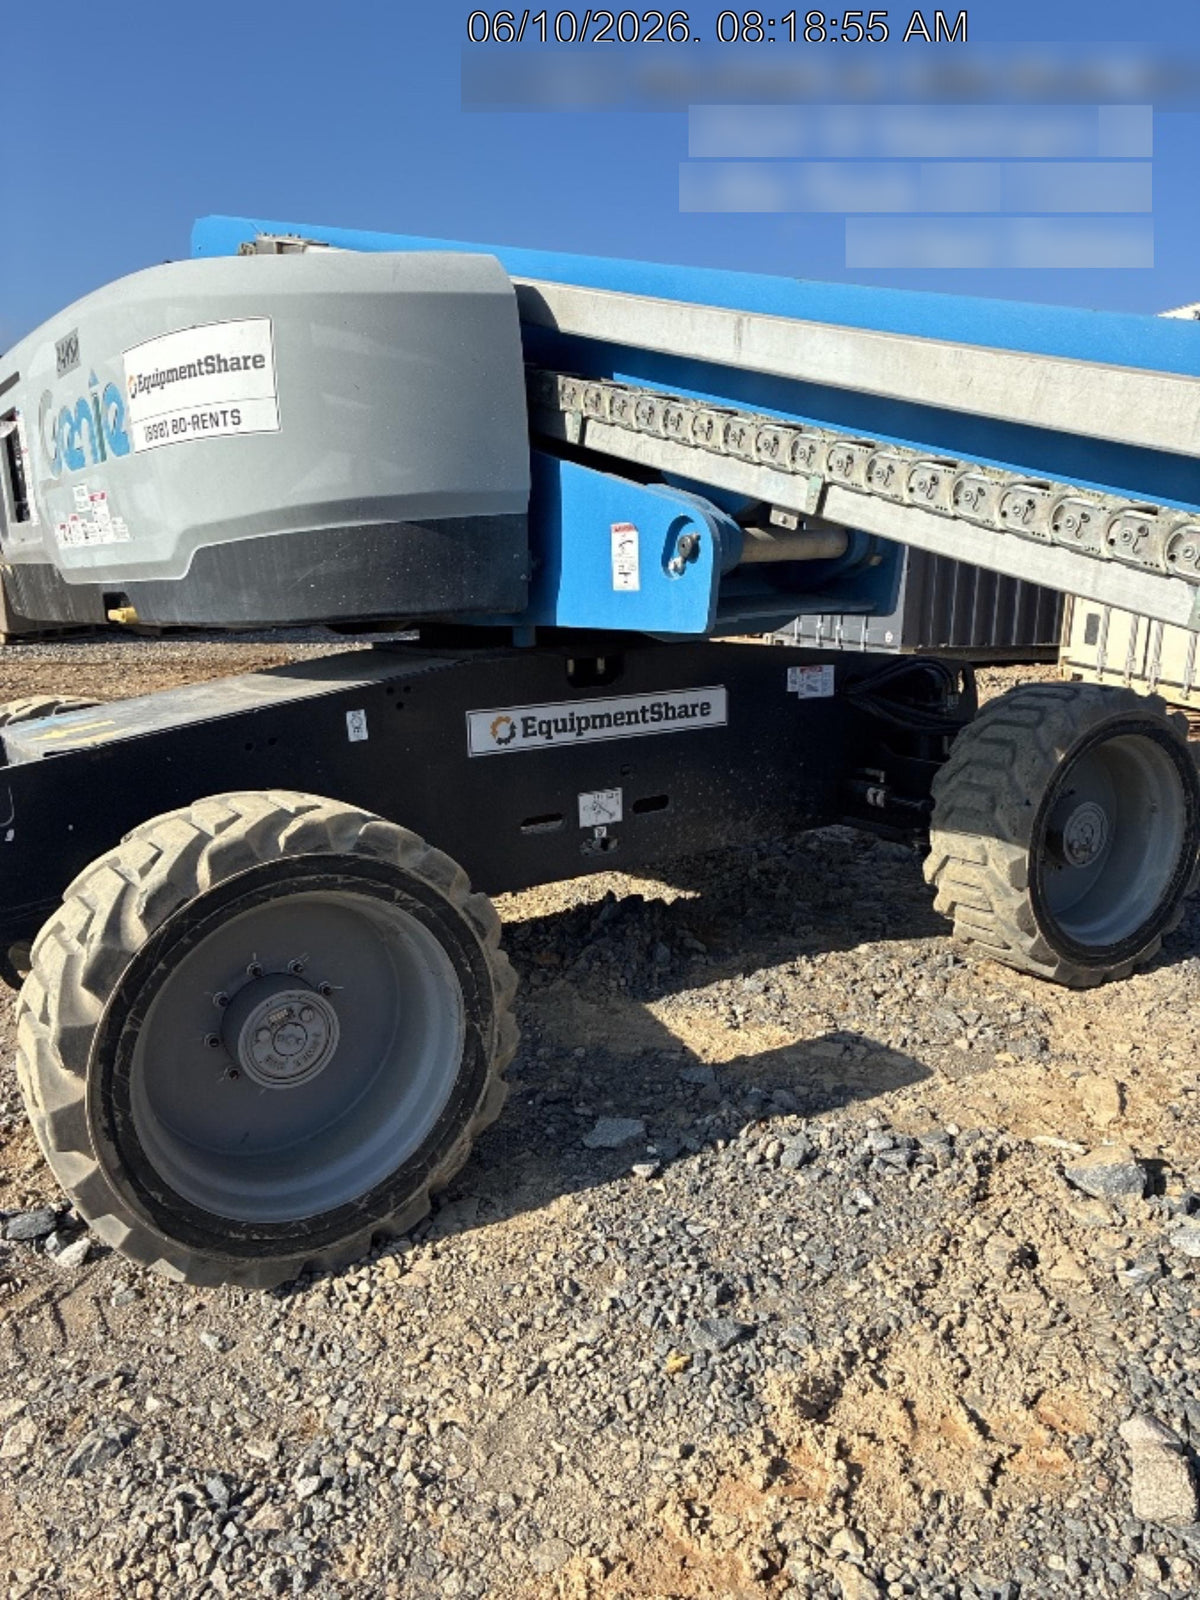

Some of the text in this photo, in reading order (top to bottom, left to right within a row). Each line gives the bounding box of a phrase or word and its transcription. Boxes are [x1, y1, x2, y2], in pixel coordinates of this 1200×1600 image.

[136, 353, 266, 394] EquipmentShare
[172, 408, 242, 435] 80-RENTS
[521, 701, 711, 740] EquipmentShare
